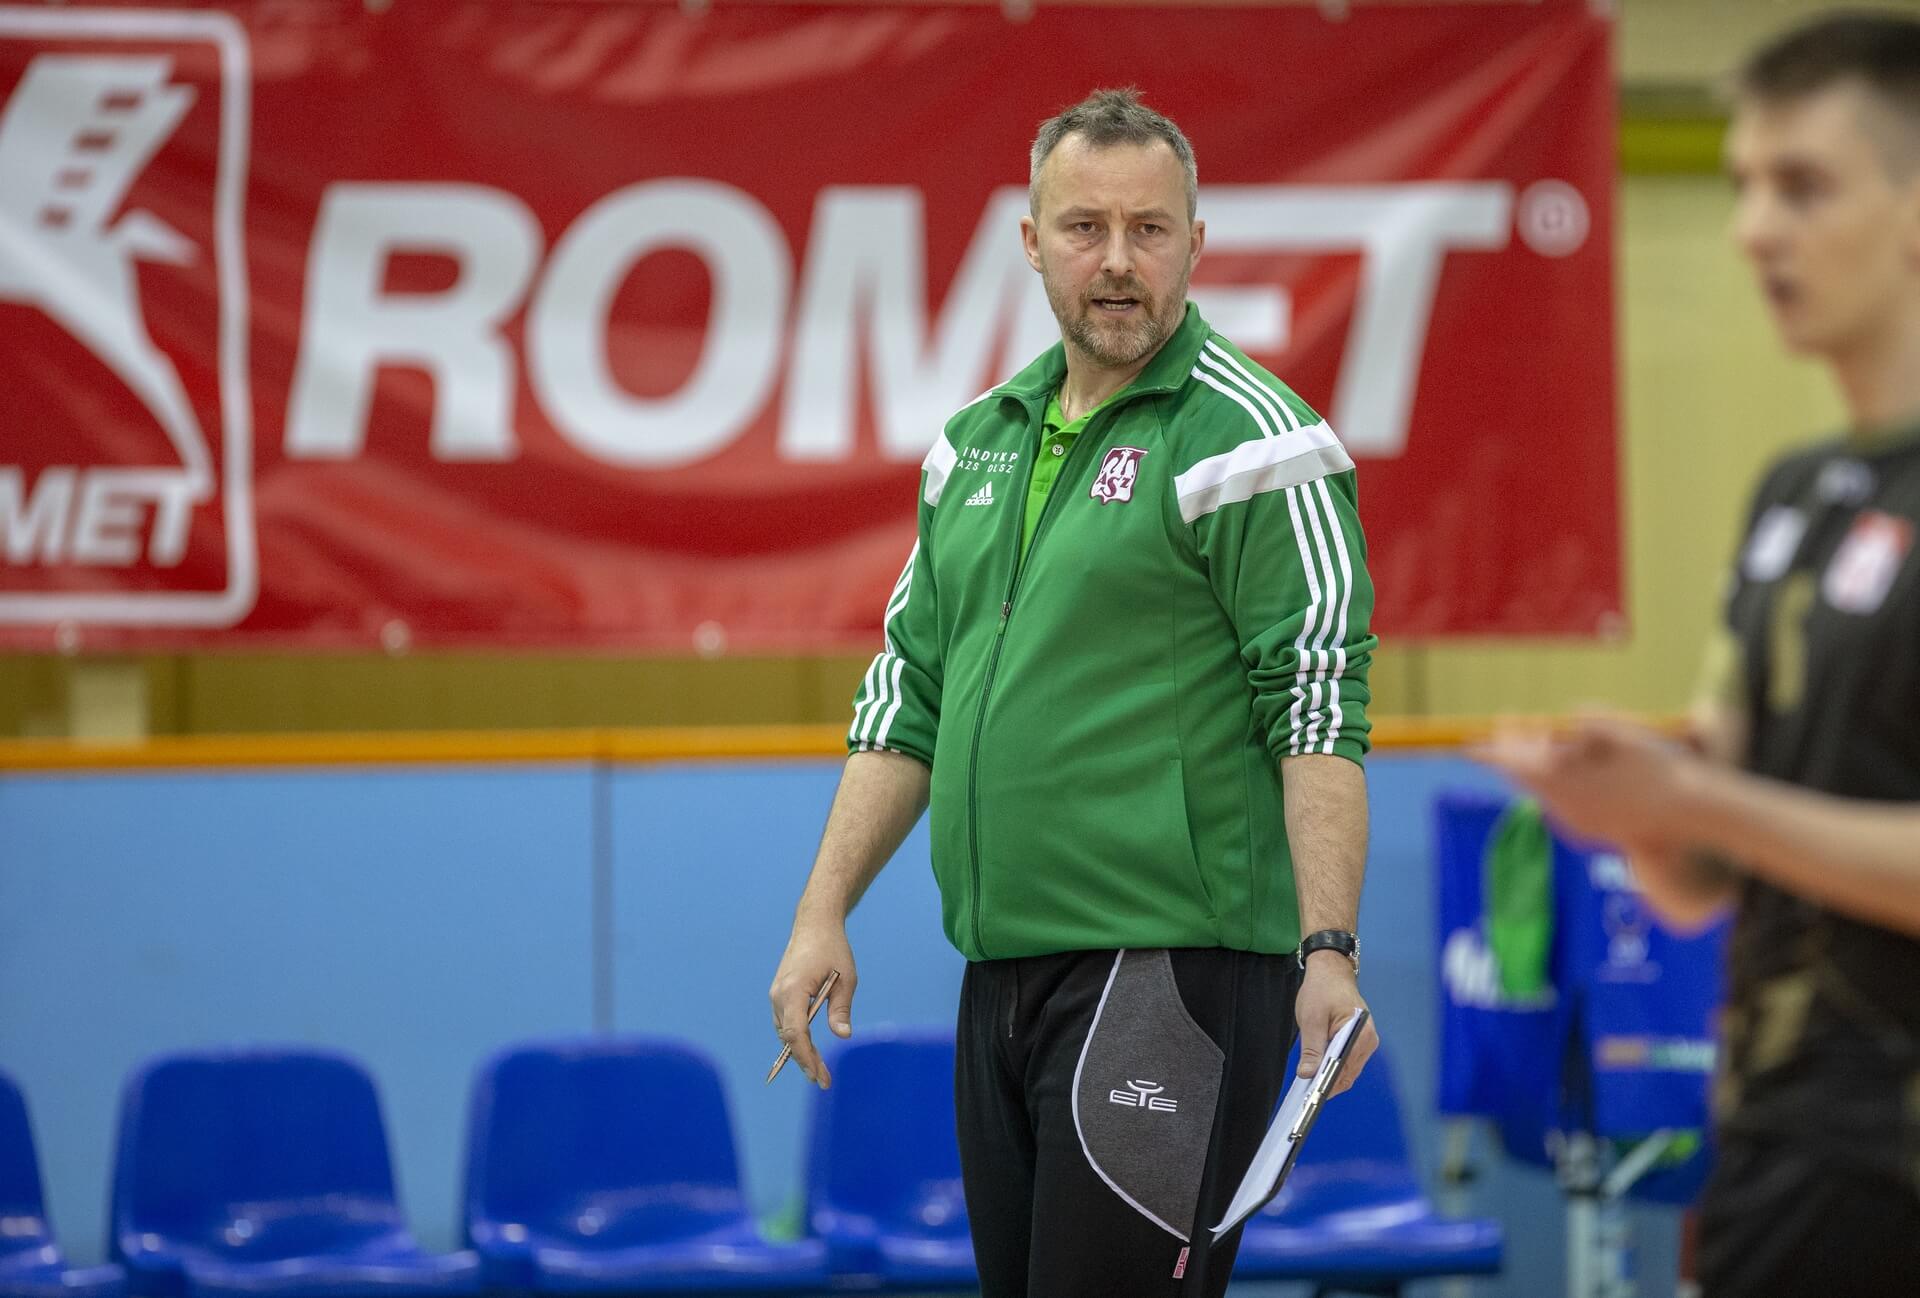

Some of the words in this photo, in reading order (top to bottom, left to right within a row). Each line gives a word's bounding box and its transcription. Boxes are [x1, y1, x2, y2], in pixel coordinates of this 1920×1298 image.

[962, 446, 1019, 463] INDYKP
[957, 459, 980, 471] AZS
[964, 497, 995, 506] adidas
